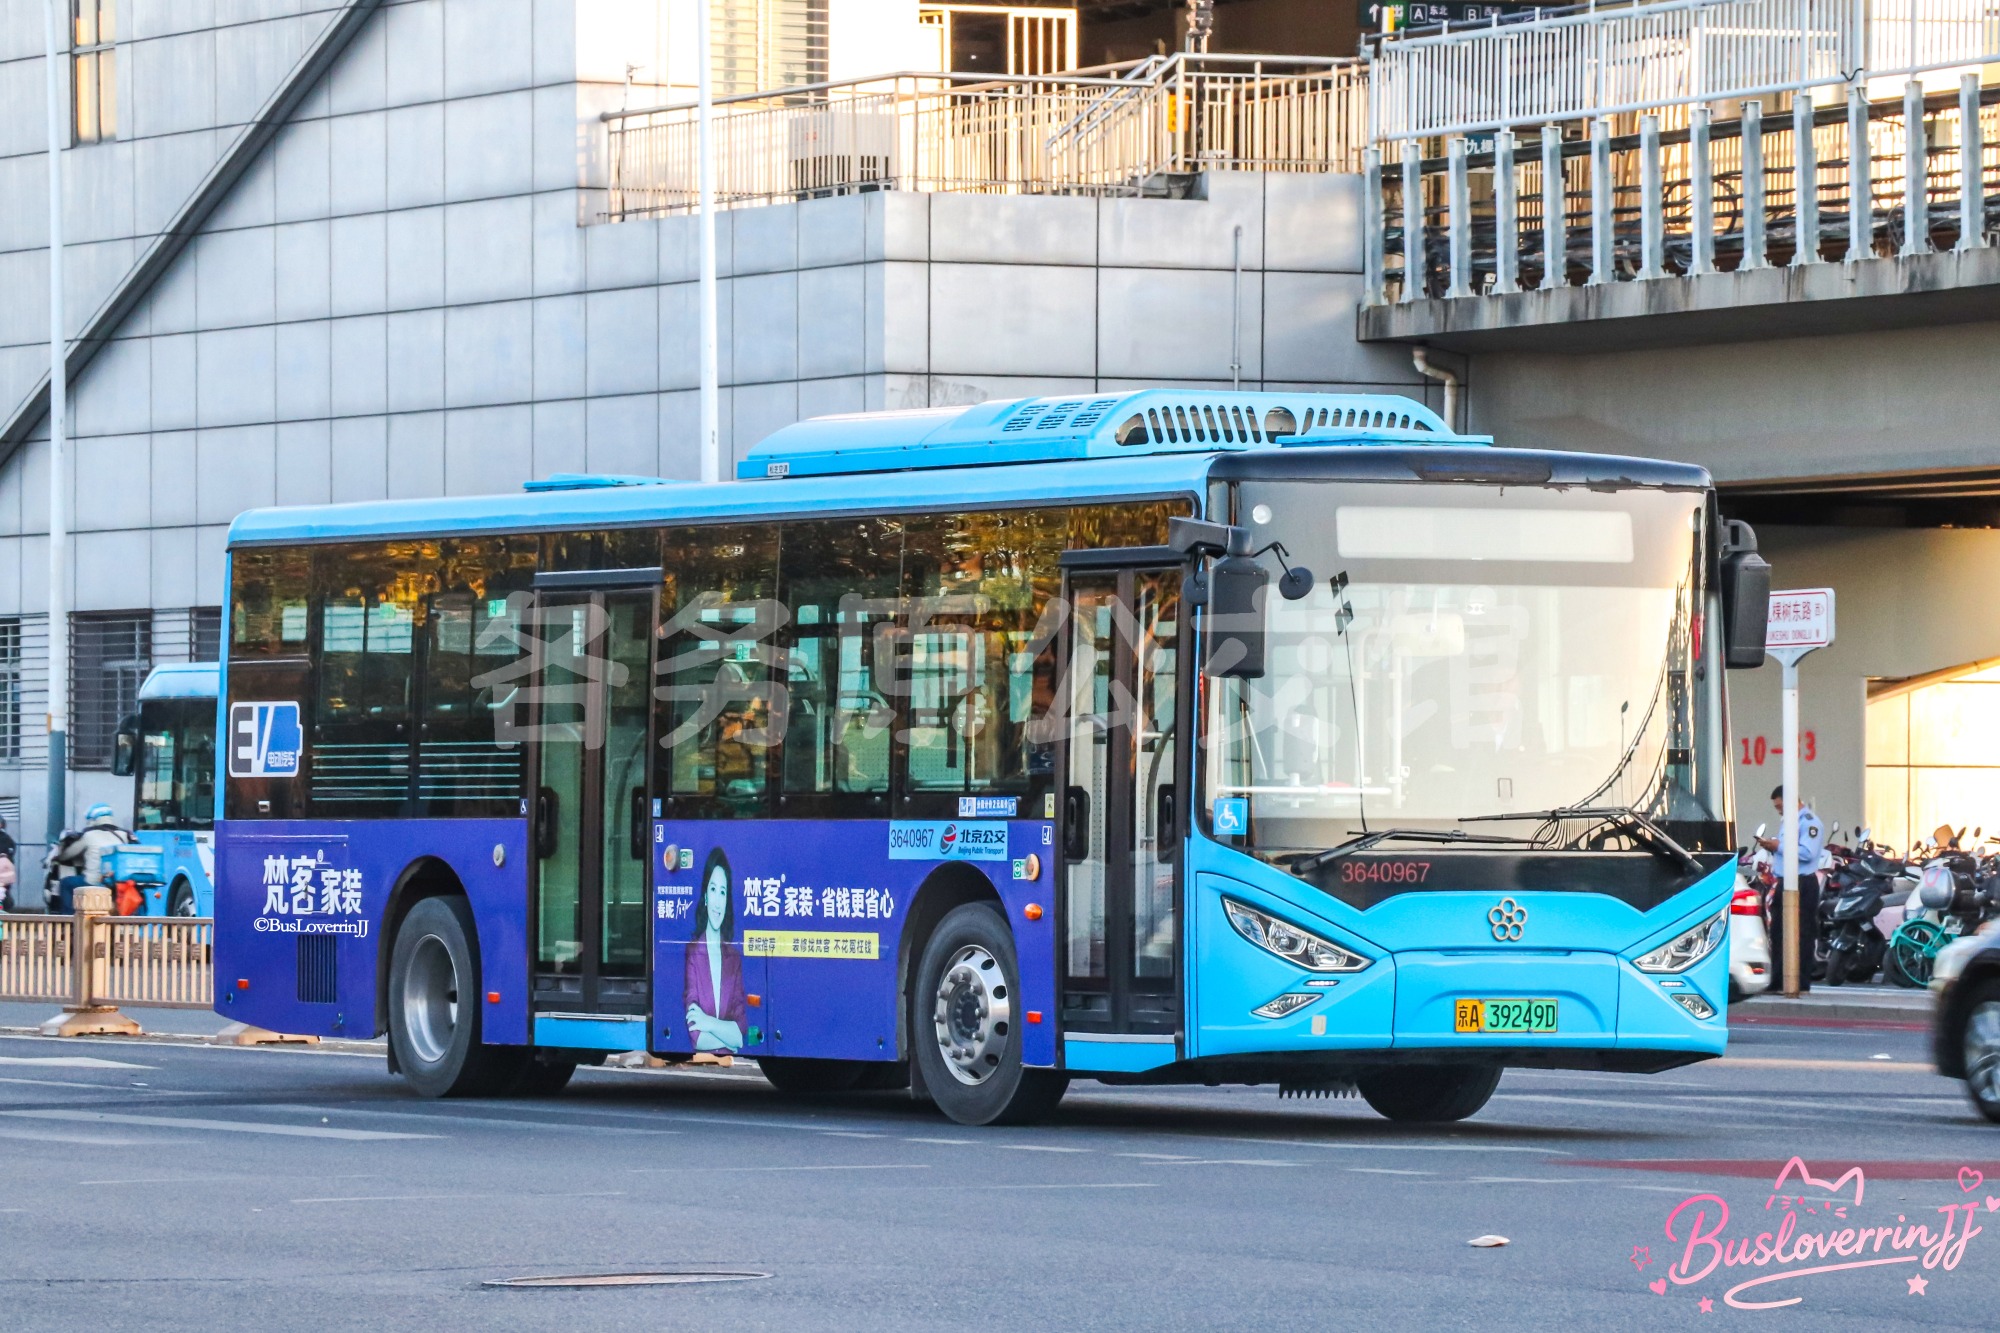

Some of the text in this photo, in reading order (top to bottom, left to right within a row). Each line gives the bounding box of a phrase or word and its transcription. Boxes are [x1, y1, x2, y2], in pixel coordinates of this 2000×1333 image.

[1414, 8, 1424, 20] A
[1429, 5, 1448, 16] 东北
[1468, 9, 1477, 20] B
[1769, 601, 1811, 623] 棵树东路
[1741, 731, 1816, 765] 10-3
[890, 828, 934, 848] 3640967
[960, 829, 1006, 844] 北京公交
[958, 846, 1004, 855] Beijing Public Transport
[1341, 861, 1430, 883] 3640967
[1457, 1004, 1556, 1028] 京A 39249D
